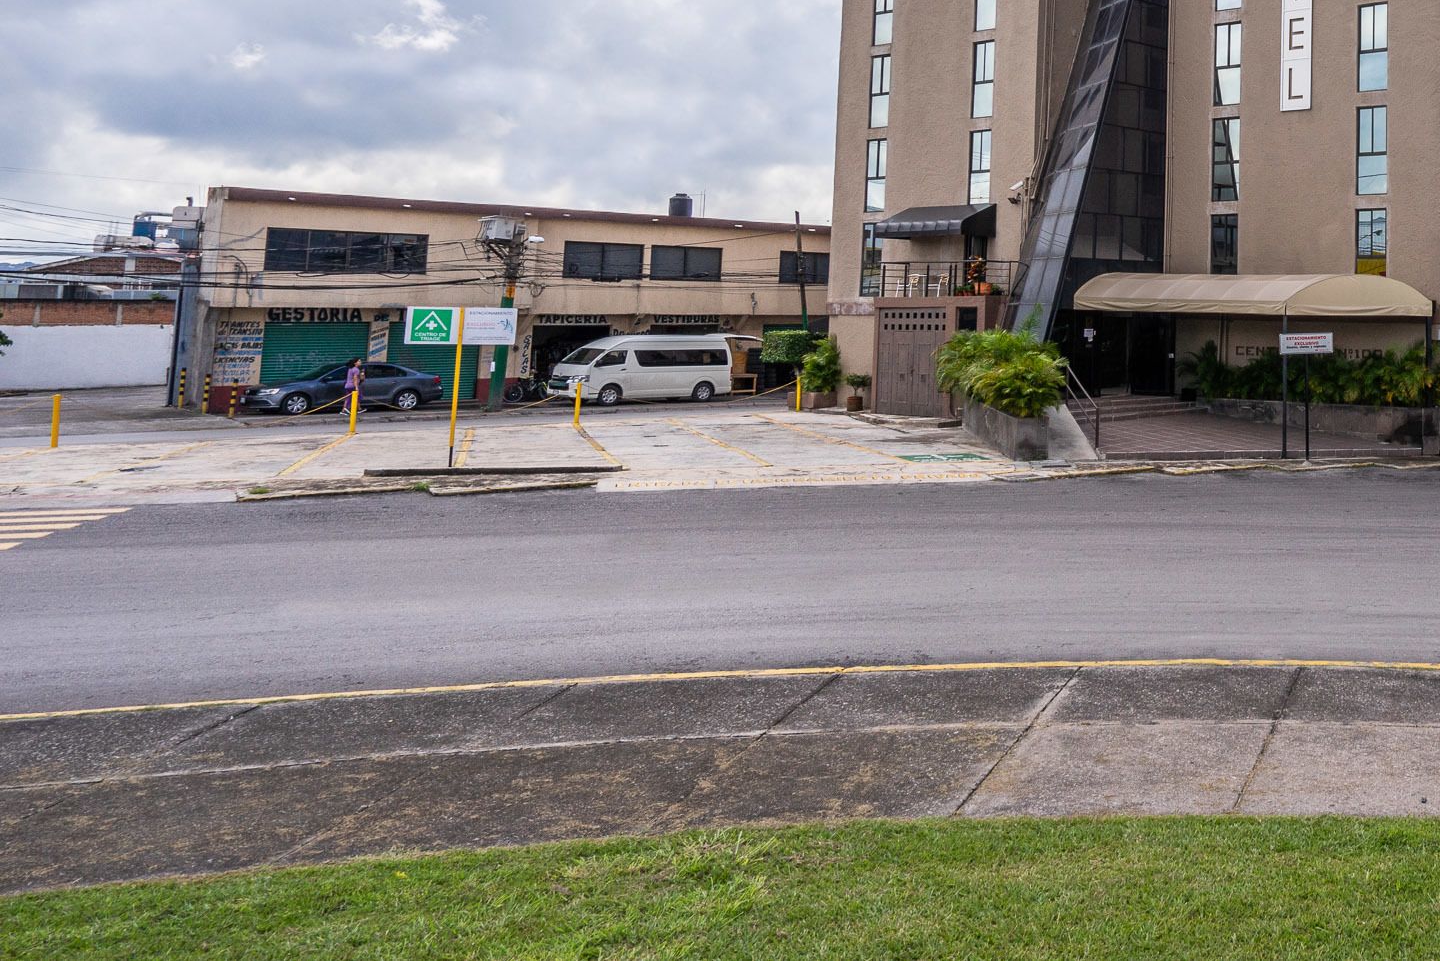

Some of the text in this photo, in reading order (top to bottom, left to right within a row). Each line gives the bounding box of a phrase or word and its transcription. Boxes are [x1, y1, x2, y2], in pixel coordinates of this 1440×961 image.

[267, 307, 362, 322] GESTORIA
[539, 314, 608, 324] TAPICERIA
[653, 314, 721, 324] VESTIDURAS
